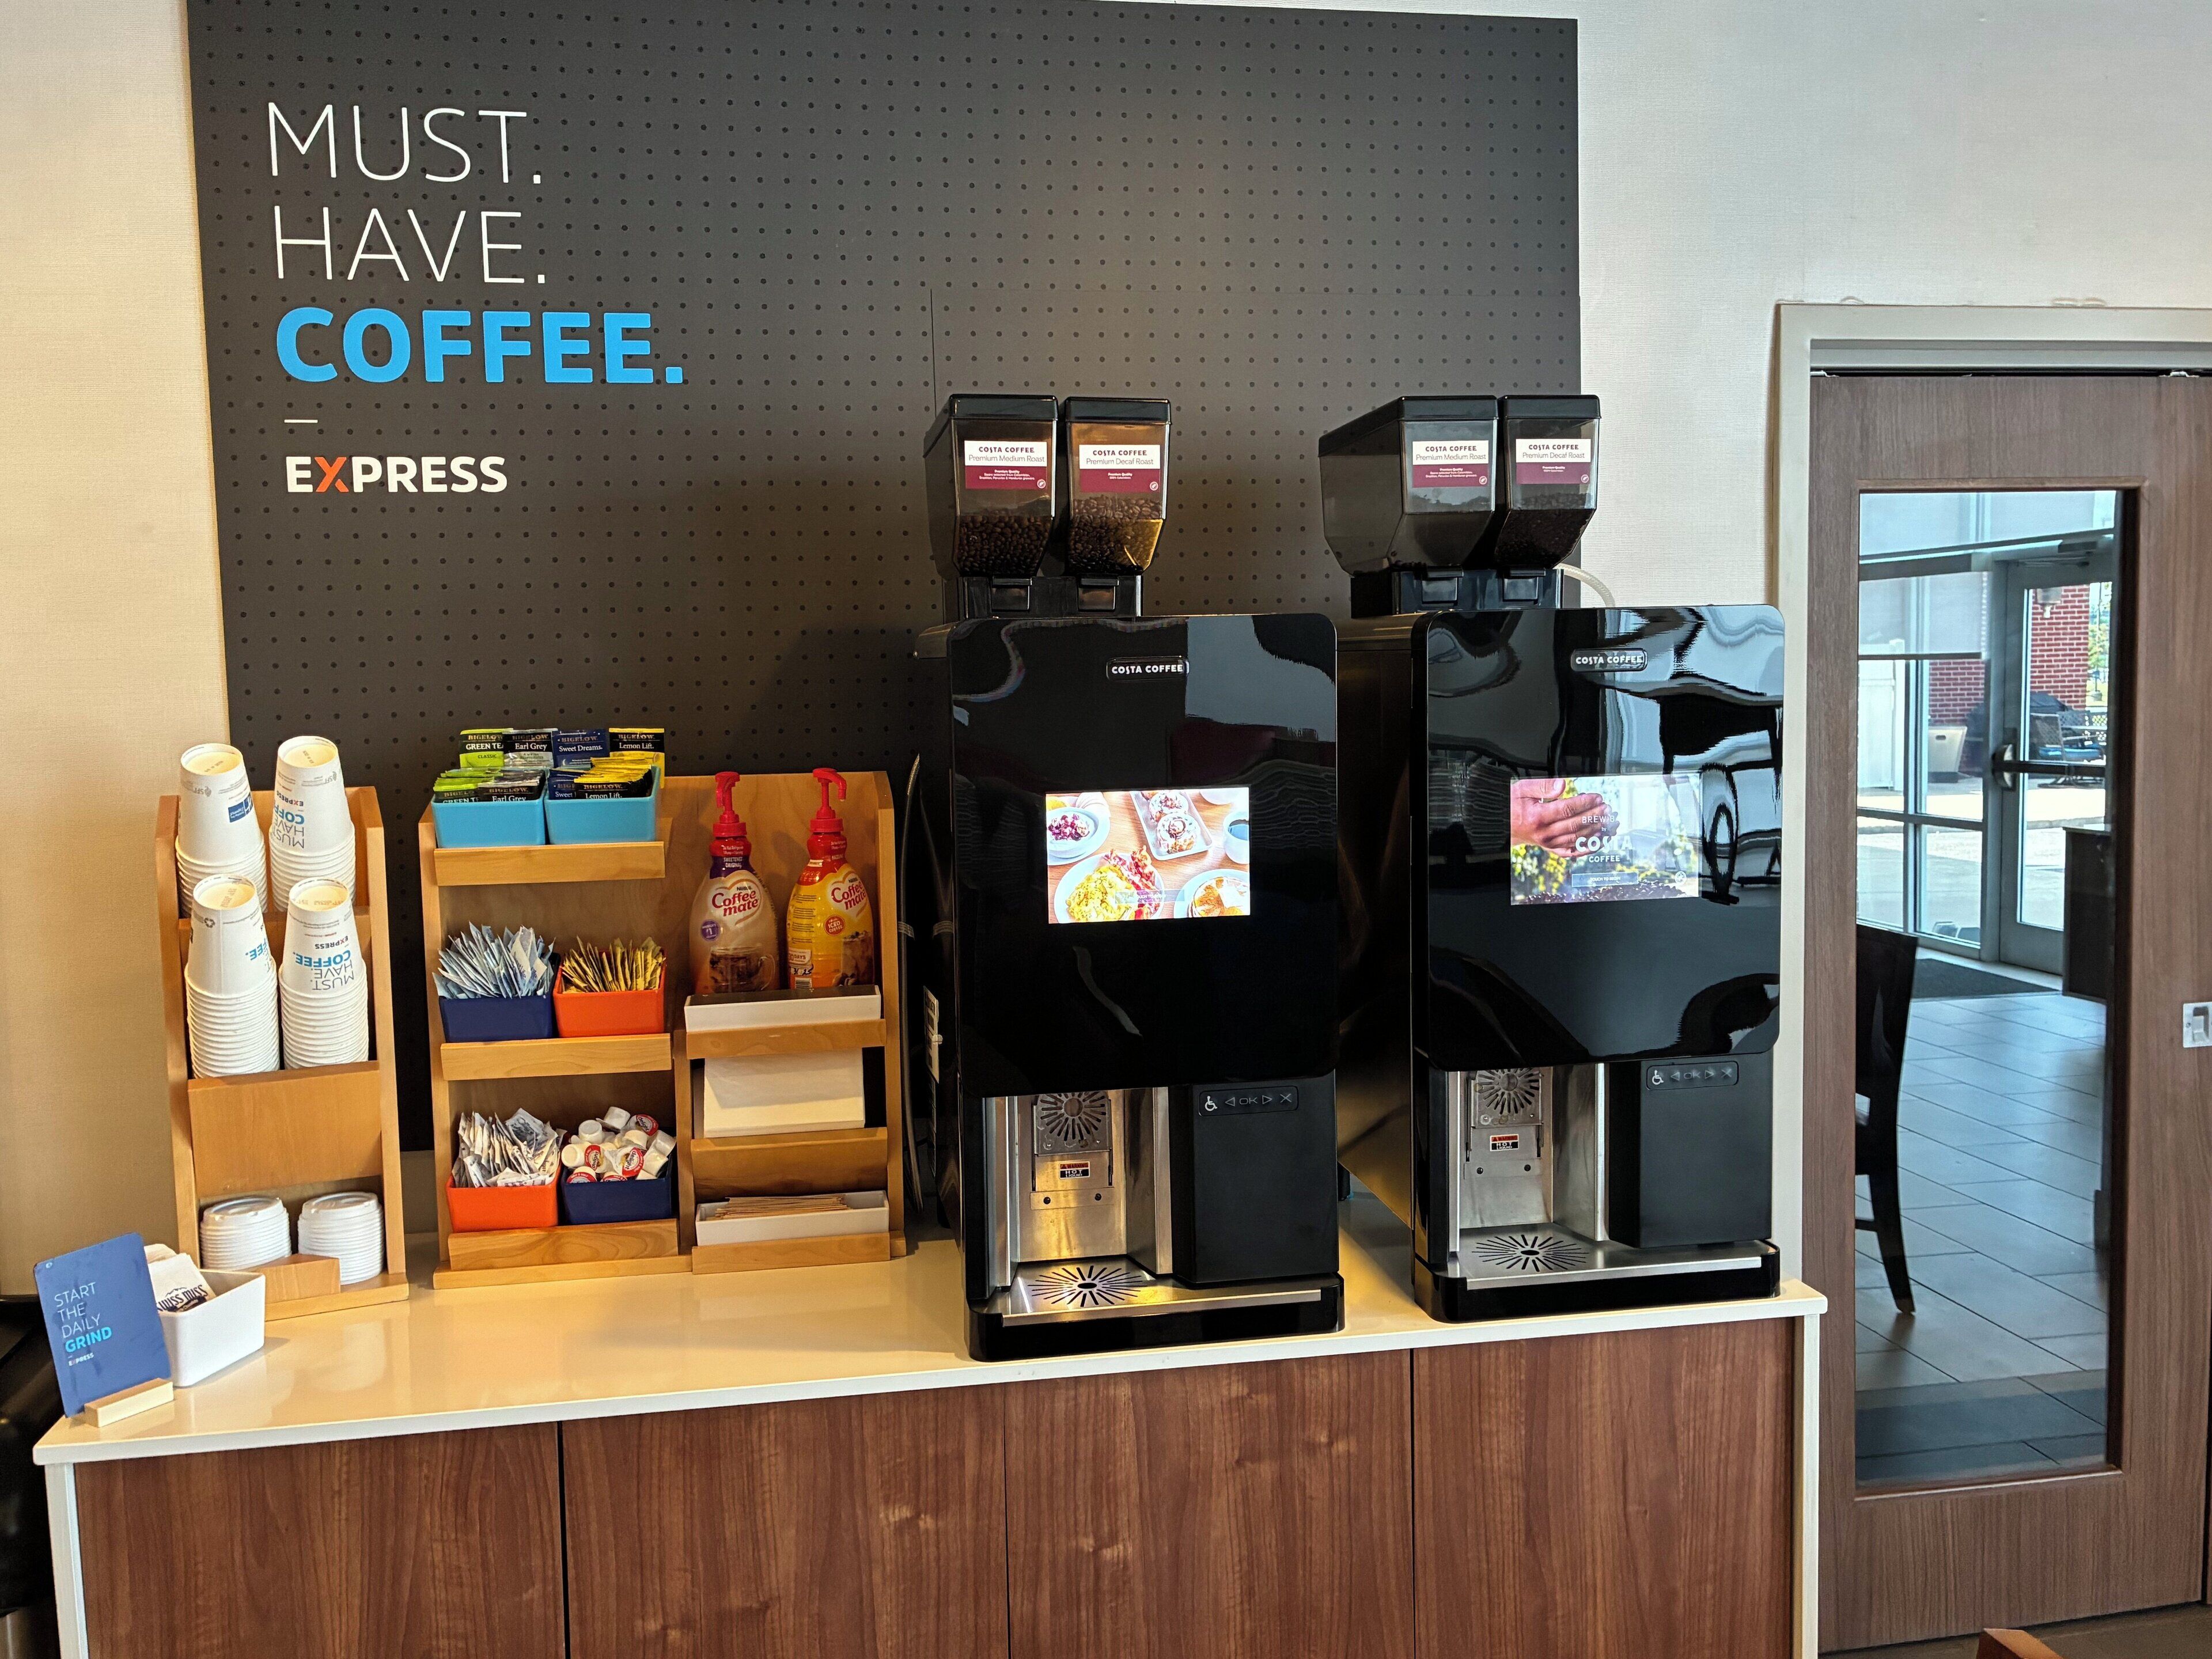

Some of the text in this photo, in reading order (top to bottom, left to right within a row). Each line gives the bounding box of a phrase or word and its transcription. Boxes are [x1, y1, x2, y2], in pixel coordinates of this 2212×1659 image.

[268, 102, 541, 184] MUST.
[274, 205, 546, 284] HAVE.
[276, 306, 683, 384] COFFEE.
[286, 456, 508, 493] EXPRESS
[1111, 664, 1183, 675] COSTA COFFEE
[1575, 655, 1643, 665] COSTA COFFEE
[530, 743, 547, 751] Grey
[276, 790, 304, 807] EXPRESS
[274, 804, 305, 825] COFF
[1582, 815, 1607, 824] BREW
[1575, 835, 1633, 854] COSTA
[1589, 855, 1621, 863] COFFEE
[711, 890, 756, 909] Coffee
[831, 880, 864, 903] Coffee
[723, 899, 758, 917] mate
[315, 935, 349, 949] EXPRESS
[293, 949, 351, 968] COFFEE.
[311, 959, 353, 979] HAVE.
[310, 970, 354, 990] MUST.
[1683, 1070, 1701, 1080] OK
[1239, 1097, 1258, 1105] OK
[624, 1149, 637, 1170] delight
[54, 1282, 96, 1307] START
[157, 1294, 184, 1312] WISS
[57, 1302, 86, 1323] THE
[61, 1313, 101, 1338] DAILY
[65, 1327, 112, 1353] GRIND
[68, 1352, 94, 1366] EXPRESS
